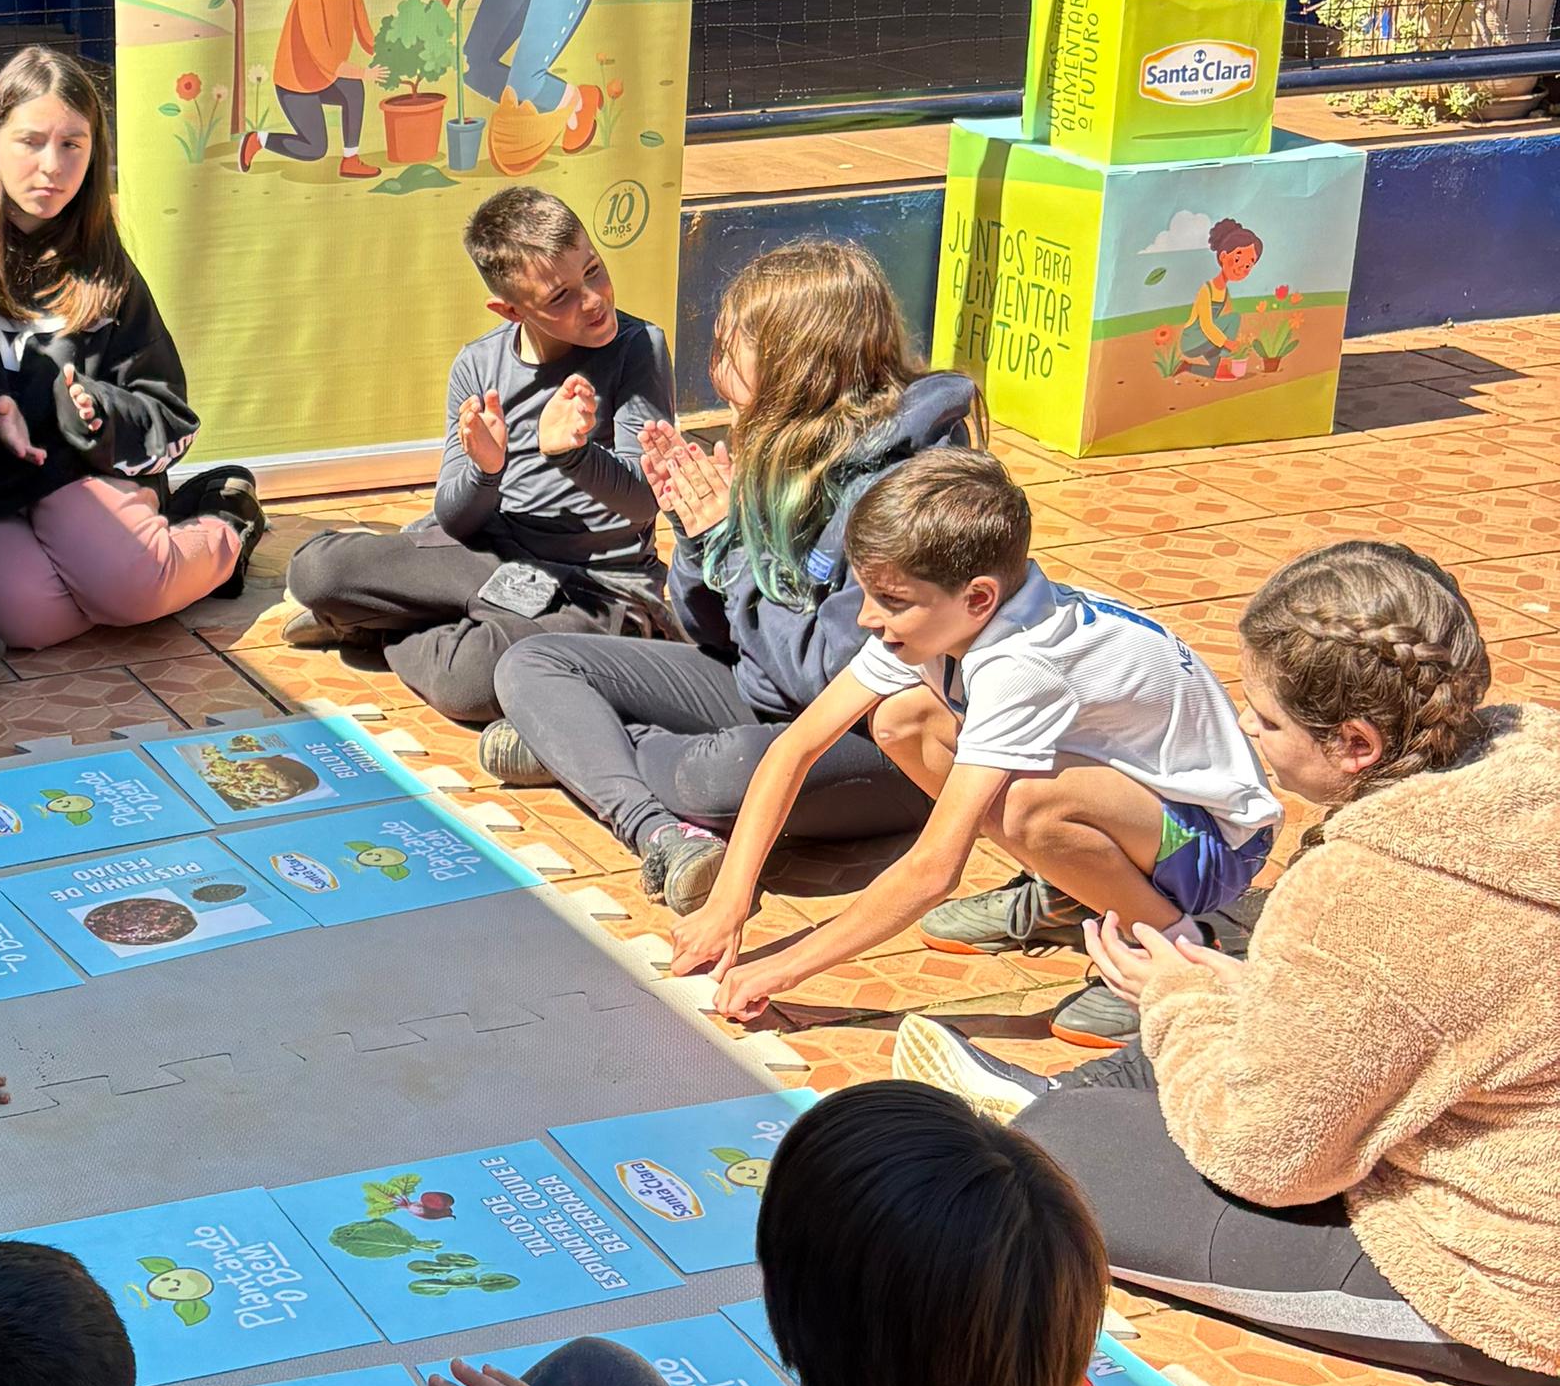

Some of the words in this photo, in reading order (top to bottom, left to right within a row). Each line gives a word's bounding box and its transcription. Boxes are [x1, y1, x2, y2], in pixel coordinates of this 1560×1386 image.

[1078, 13, 1100, 110] FUTURO
[1146, 64, 1200, 85] Santa
[1203, 60, 1251, 81] Clara
[1046, 42, 1064, 137] JUNTOS
[606, 192, 635, 225] 10
[602, 223, 632, 236] anos
[948, 211, 1027, 276] JUNTOS
[1034, 245, 1072, 286] PARA
[969, 314, 1053, 380] FUTURO
[305, 743, 327, 756] DE
[319, 755, 359, 780] BOLO
[75, 772, 146, 827] Plantando
[379, 820, 467, 882] Plantando
[49, 885, 84, 902] DE
[86, 862, 202, 894] PASTINHA
[480, 1156, 508, 1168] E
[631, 1163, 663, 1189] Clara
[481, 1194, 517, 1216] DE
[489, 1166, 549, 1211] COUVE
[656, 1187, 693, 1218] Santa
[536, 1174, 632, 1255] BETERRABA
[500, 1214, 557, 1258] TALOS
[536, 1209, 630, 1291] ESPINAFRE,
[186, 1226, 285, 1329] Plantando
